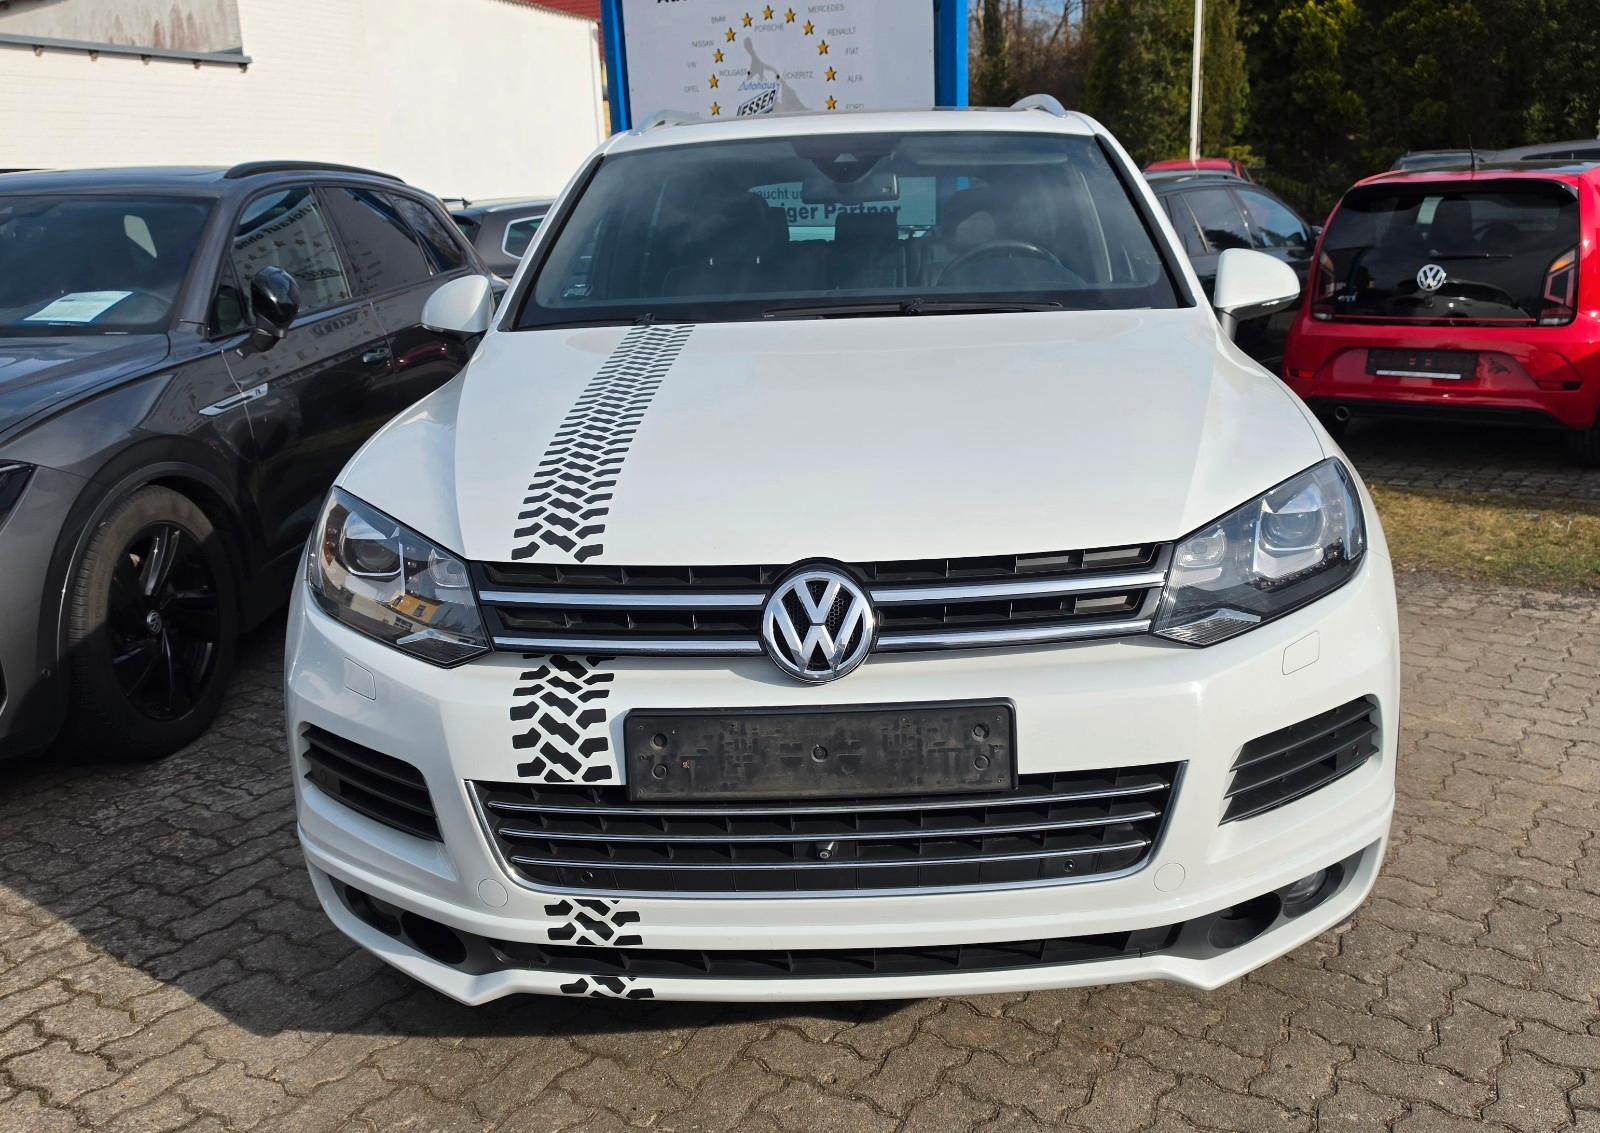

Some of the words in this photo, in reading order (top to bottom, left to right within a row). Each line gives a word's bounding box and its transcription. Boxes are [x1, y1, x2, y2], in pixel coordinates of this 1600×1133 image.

[808, 3, 845, 13] MERCEDES
[754, 23, 784, 32] PORSCHE
[827, 27, 856, 36] RENAULT
[691, 40, 714, 48] NISSAN
[757, 187, 789, 200] aucht
[786, 205, 818, 223] ger
[763, 571, 875, 683] VW
